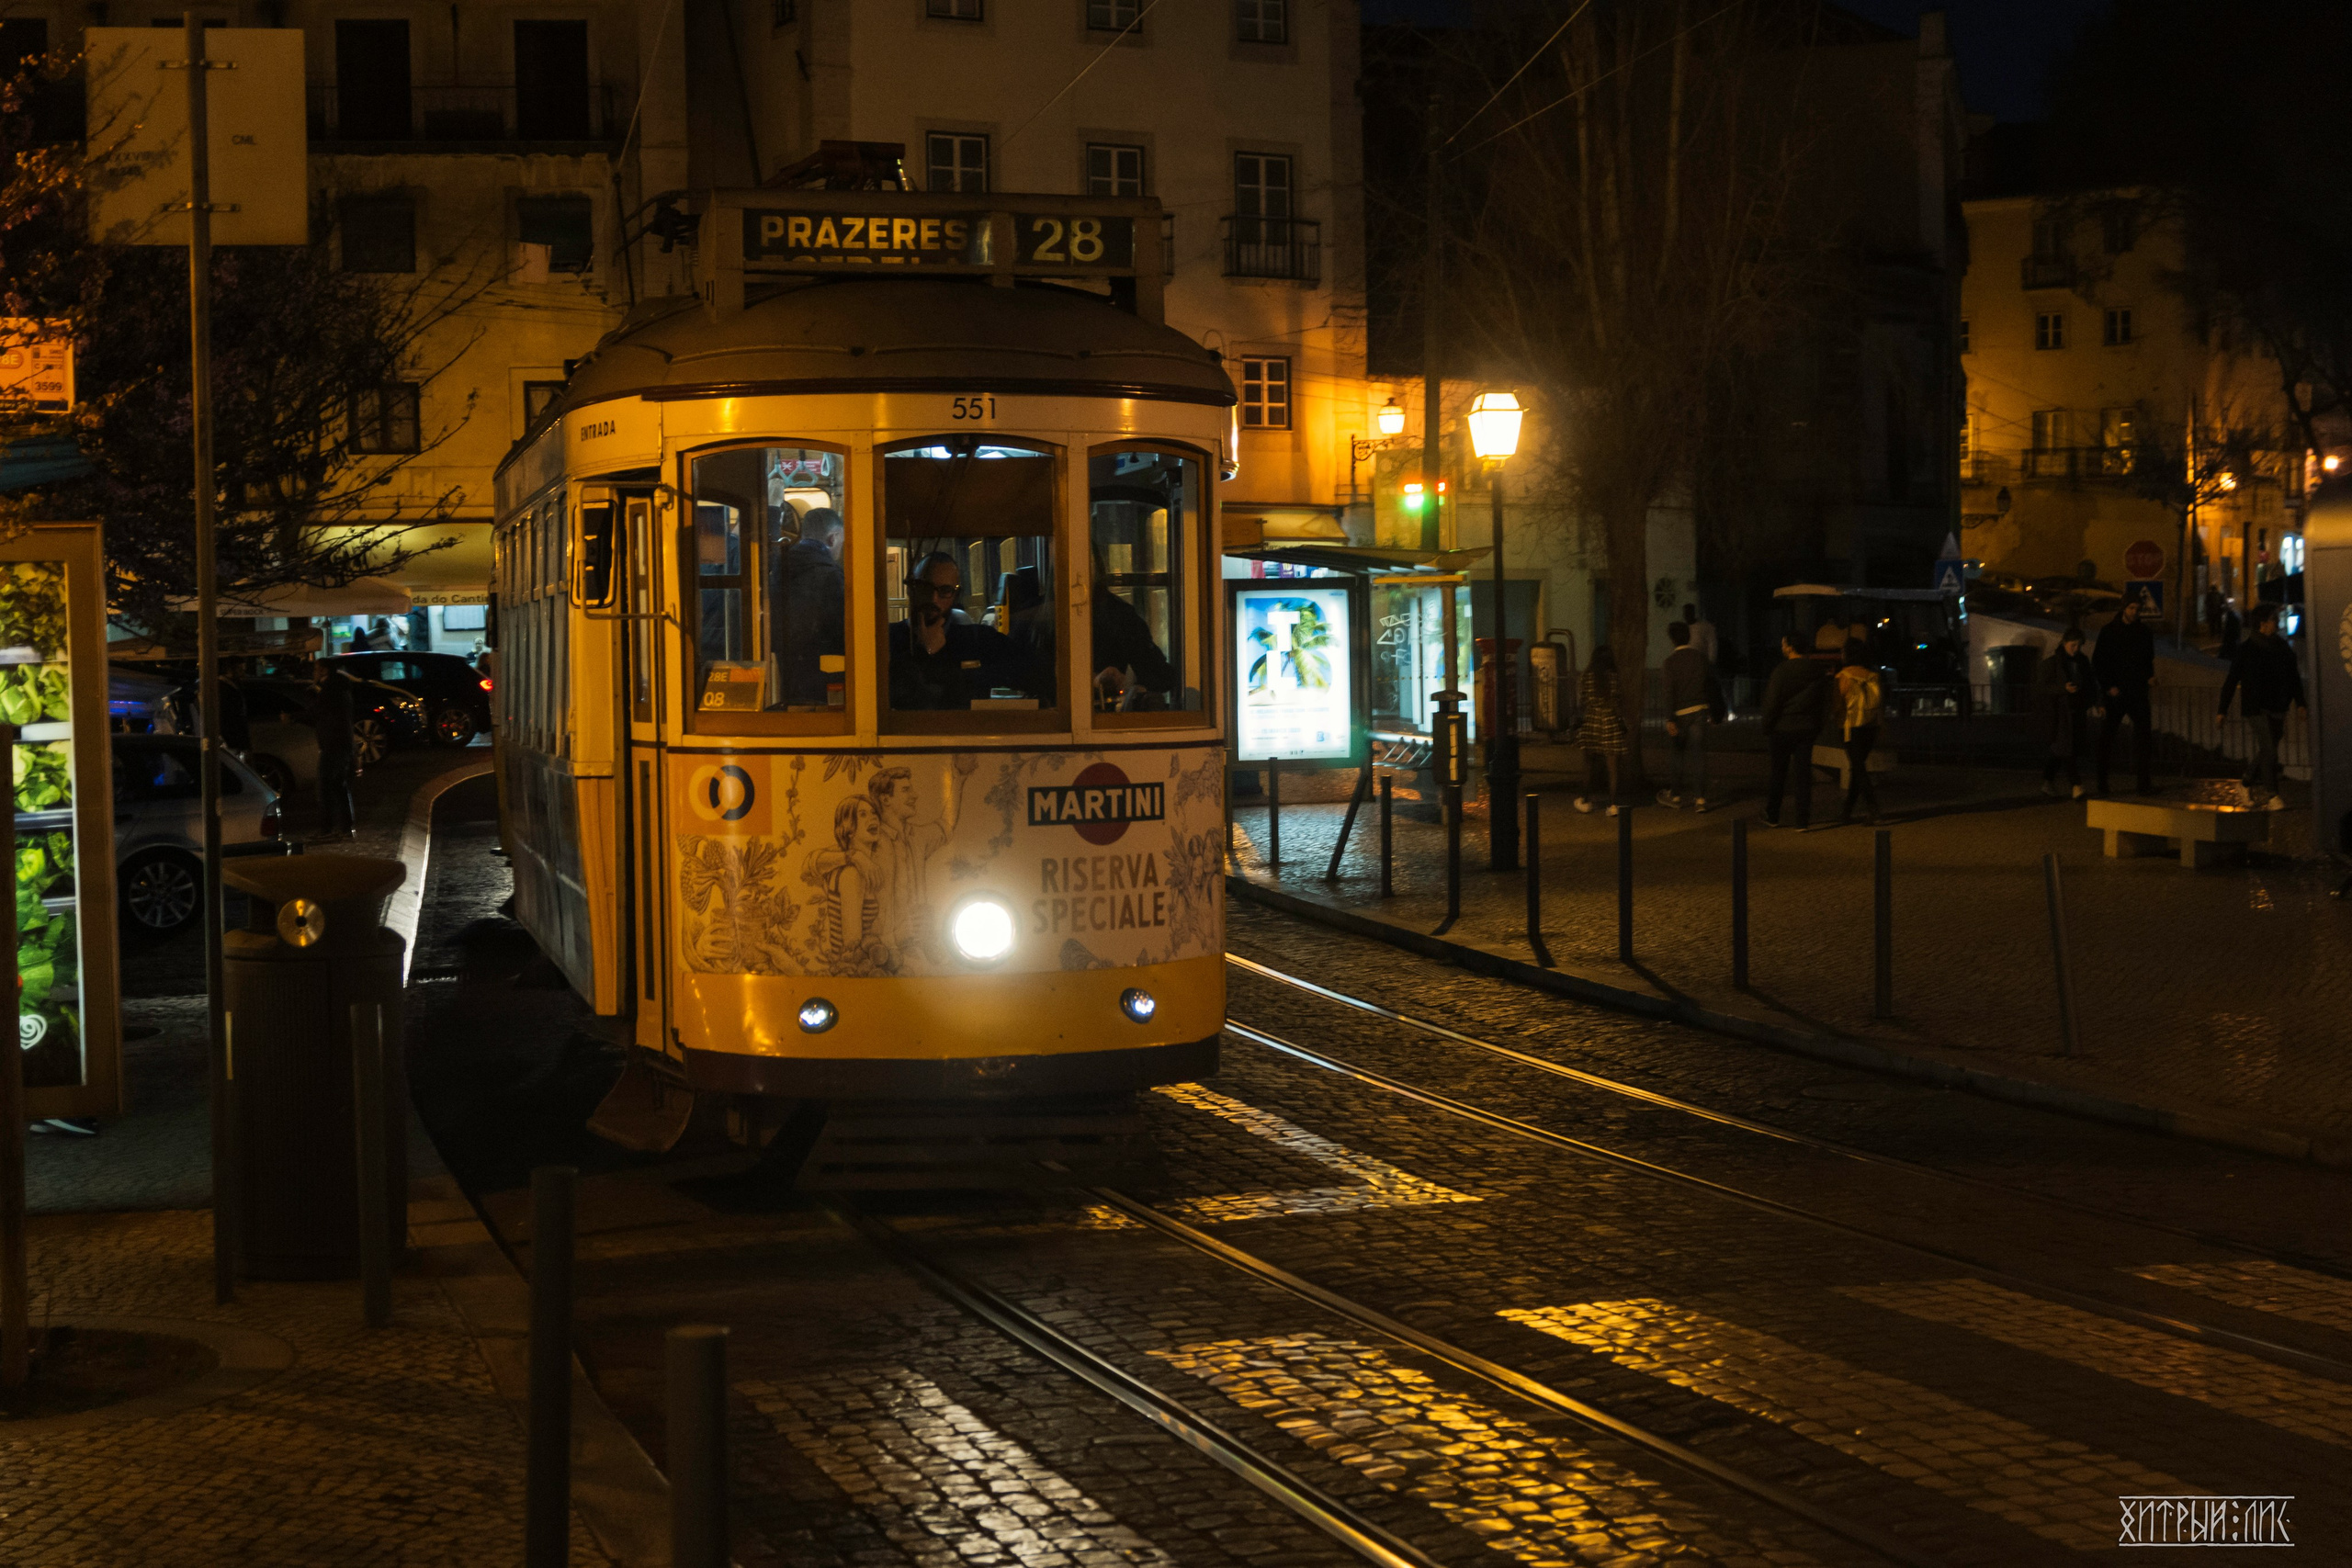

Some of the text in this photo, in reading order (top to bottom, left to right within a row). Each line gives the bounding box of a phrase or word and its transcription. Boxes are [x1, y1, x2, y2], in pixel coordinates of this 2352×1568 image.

[760, 215, 968, 250] PRAZERES
[1032, 218, 1104, 262] 28
[35, 382, 62, 391] 3599
[952, 398, 996, 420] 551
[581, 420, 616, 441] ENTRADA
[431, 595, 447, 604] do
[707, 671, 729, 682] 28E
[1033, 786, 1161, 822] MARTINI
[1041, 852, 1159, 894] RISERVA
[1032, 891, 1166, 934] SPECIALE
